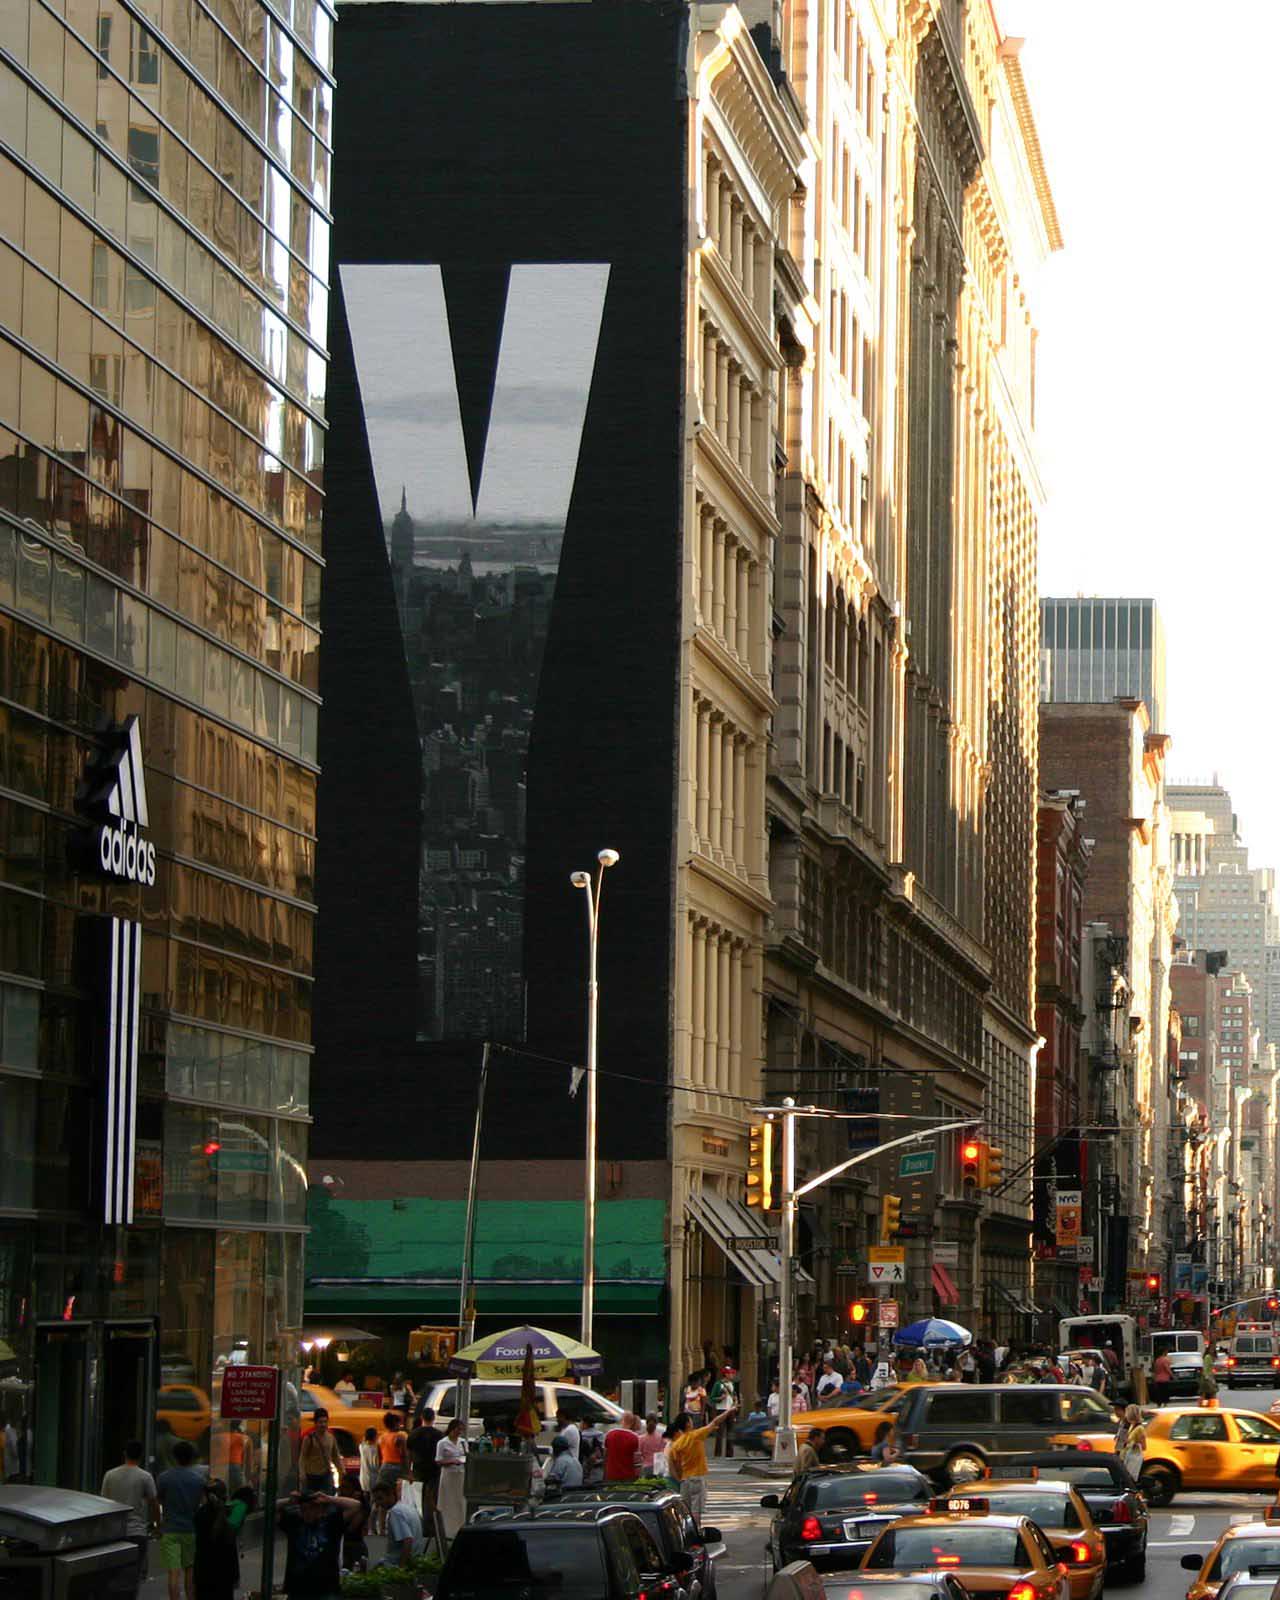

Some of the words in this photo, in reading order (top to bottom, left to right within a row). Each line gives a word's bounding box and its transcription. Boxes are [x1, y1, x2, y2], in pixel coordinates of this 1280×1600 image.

[101, 818, 156, 886] adidas
[1059, 1195, 1078, 1203] NYC
[728, 1239, 733, 1249] E
[735, 1239, 768, 1250] HOUSTON
[769, 1239, 777, 1250] ST
[1079, 1246, 1091, 1255] 30
